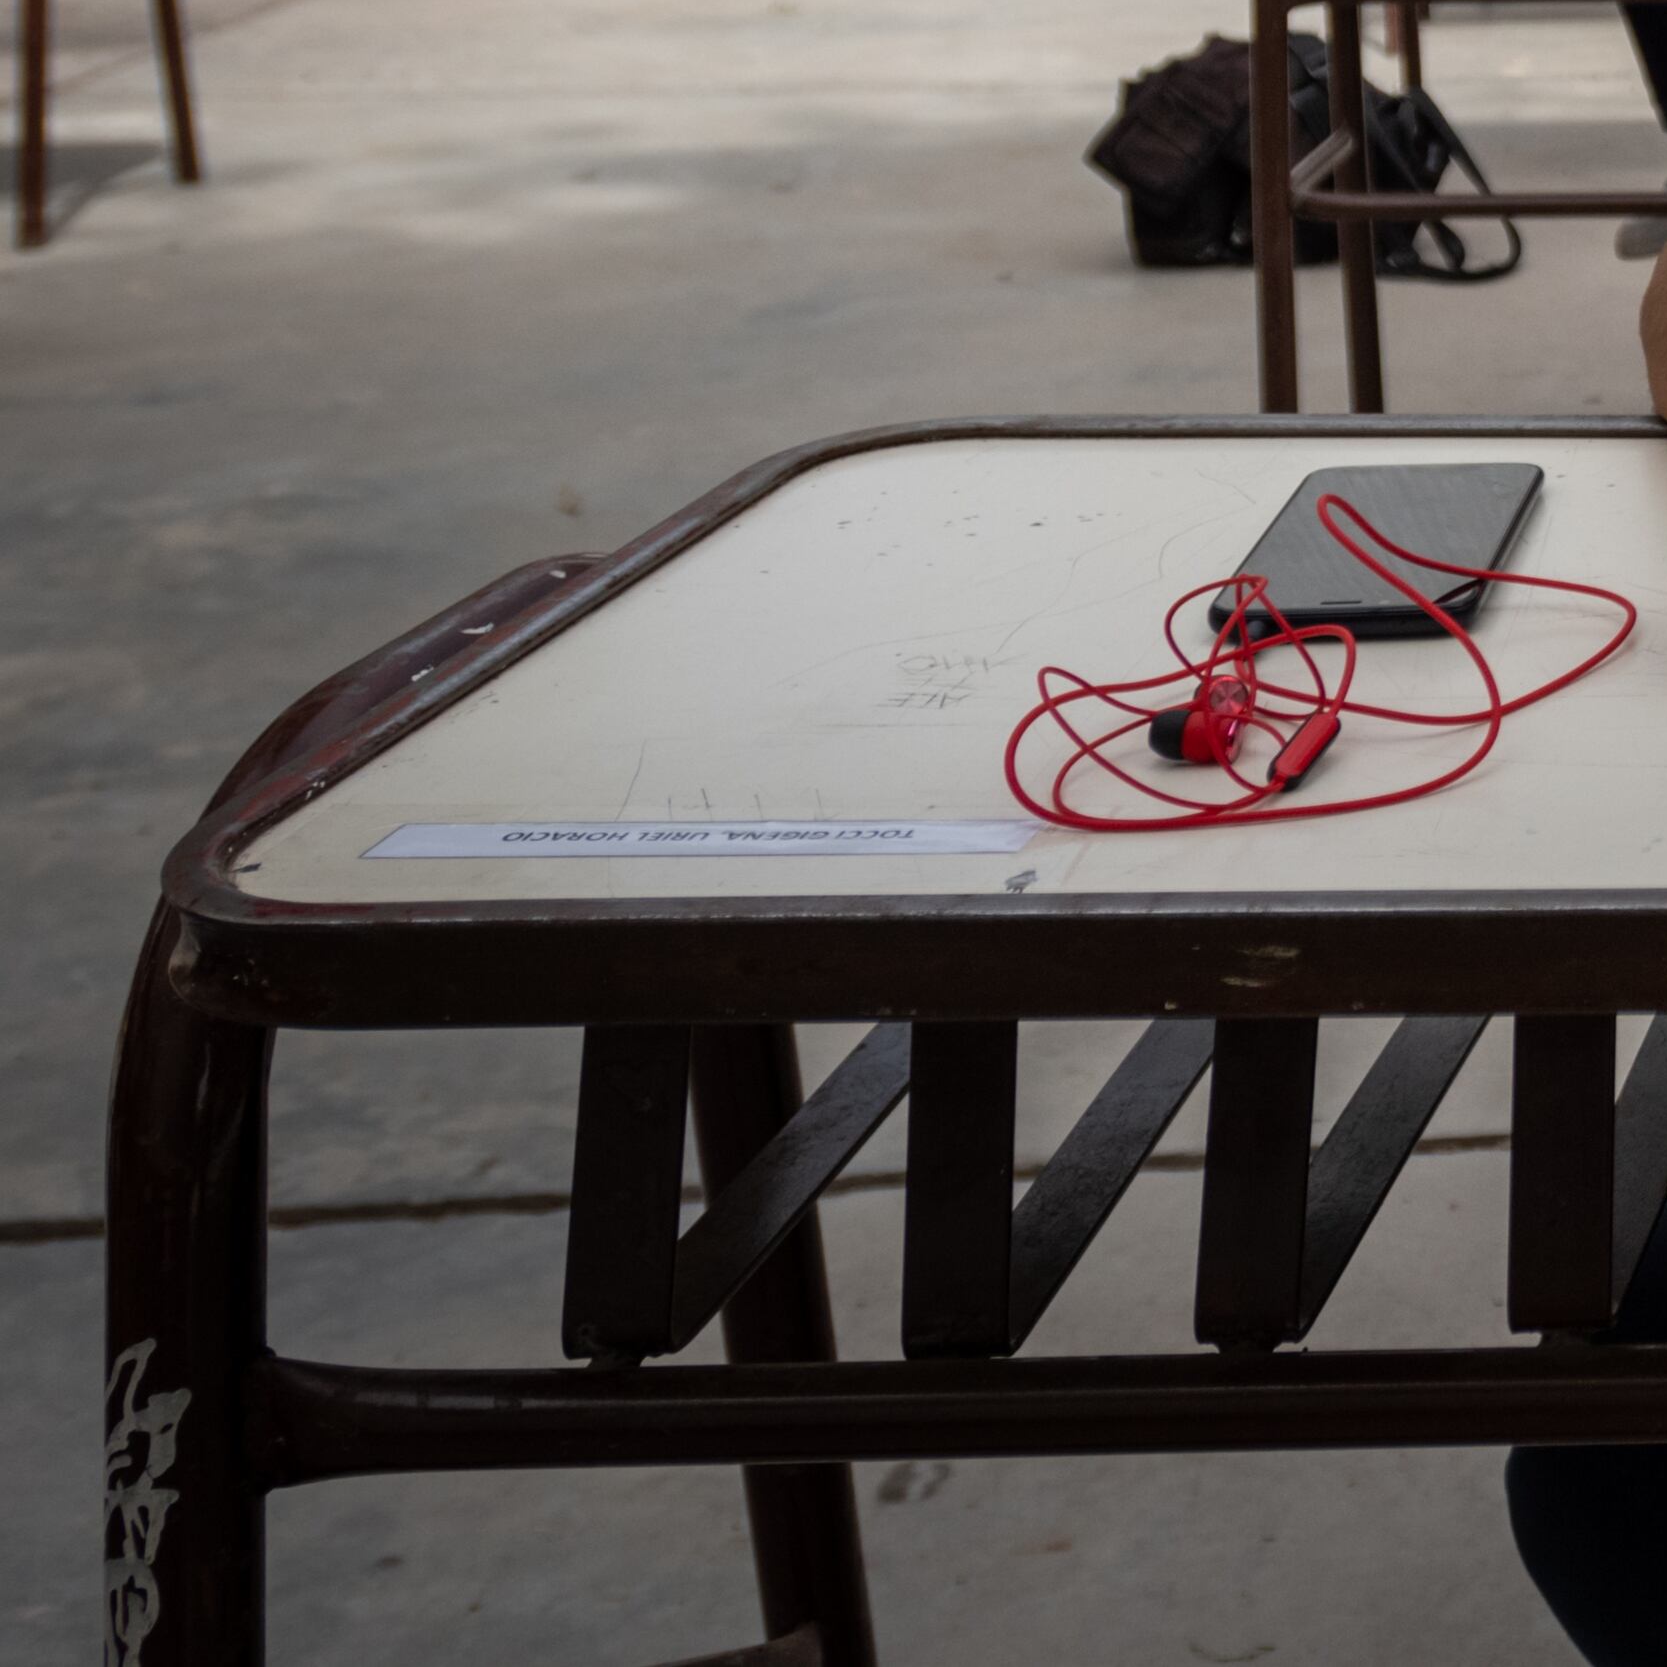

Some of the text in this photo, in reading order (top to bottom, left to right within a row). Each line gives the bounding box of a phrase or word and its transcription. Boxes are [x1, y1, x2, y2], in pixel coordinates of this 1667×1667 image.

[501, 831, 630, 842] HORACIO
[637, 830, 712, 841] URIEL
[837, 828, 915, 839] TOCCI
